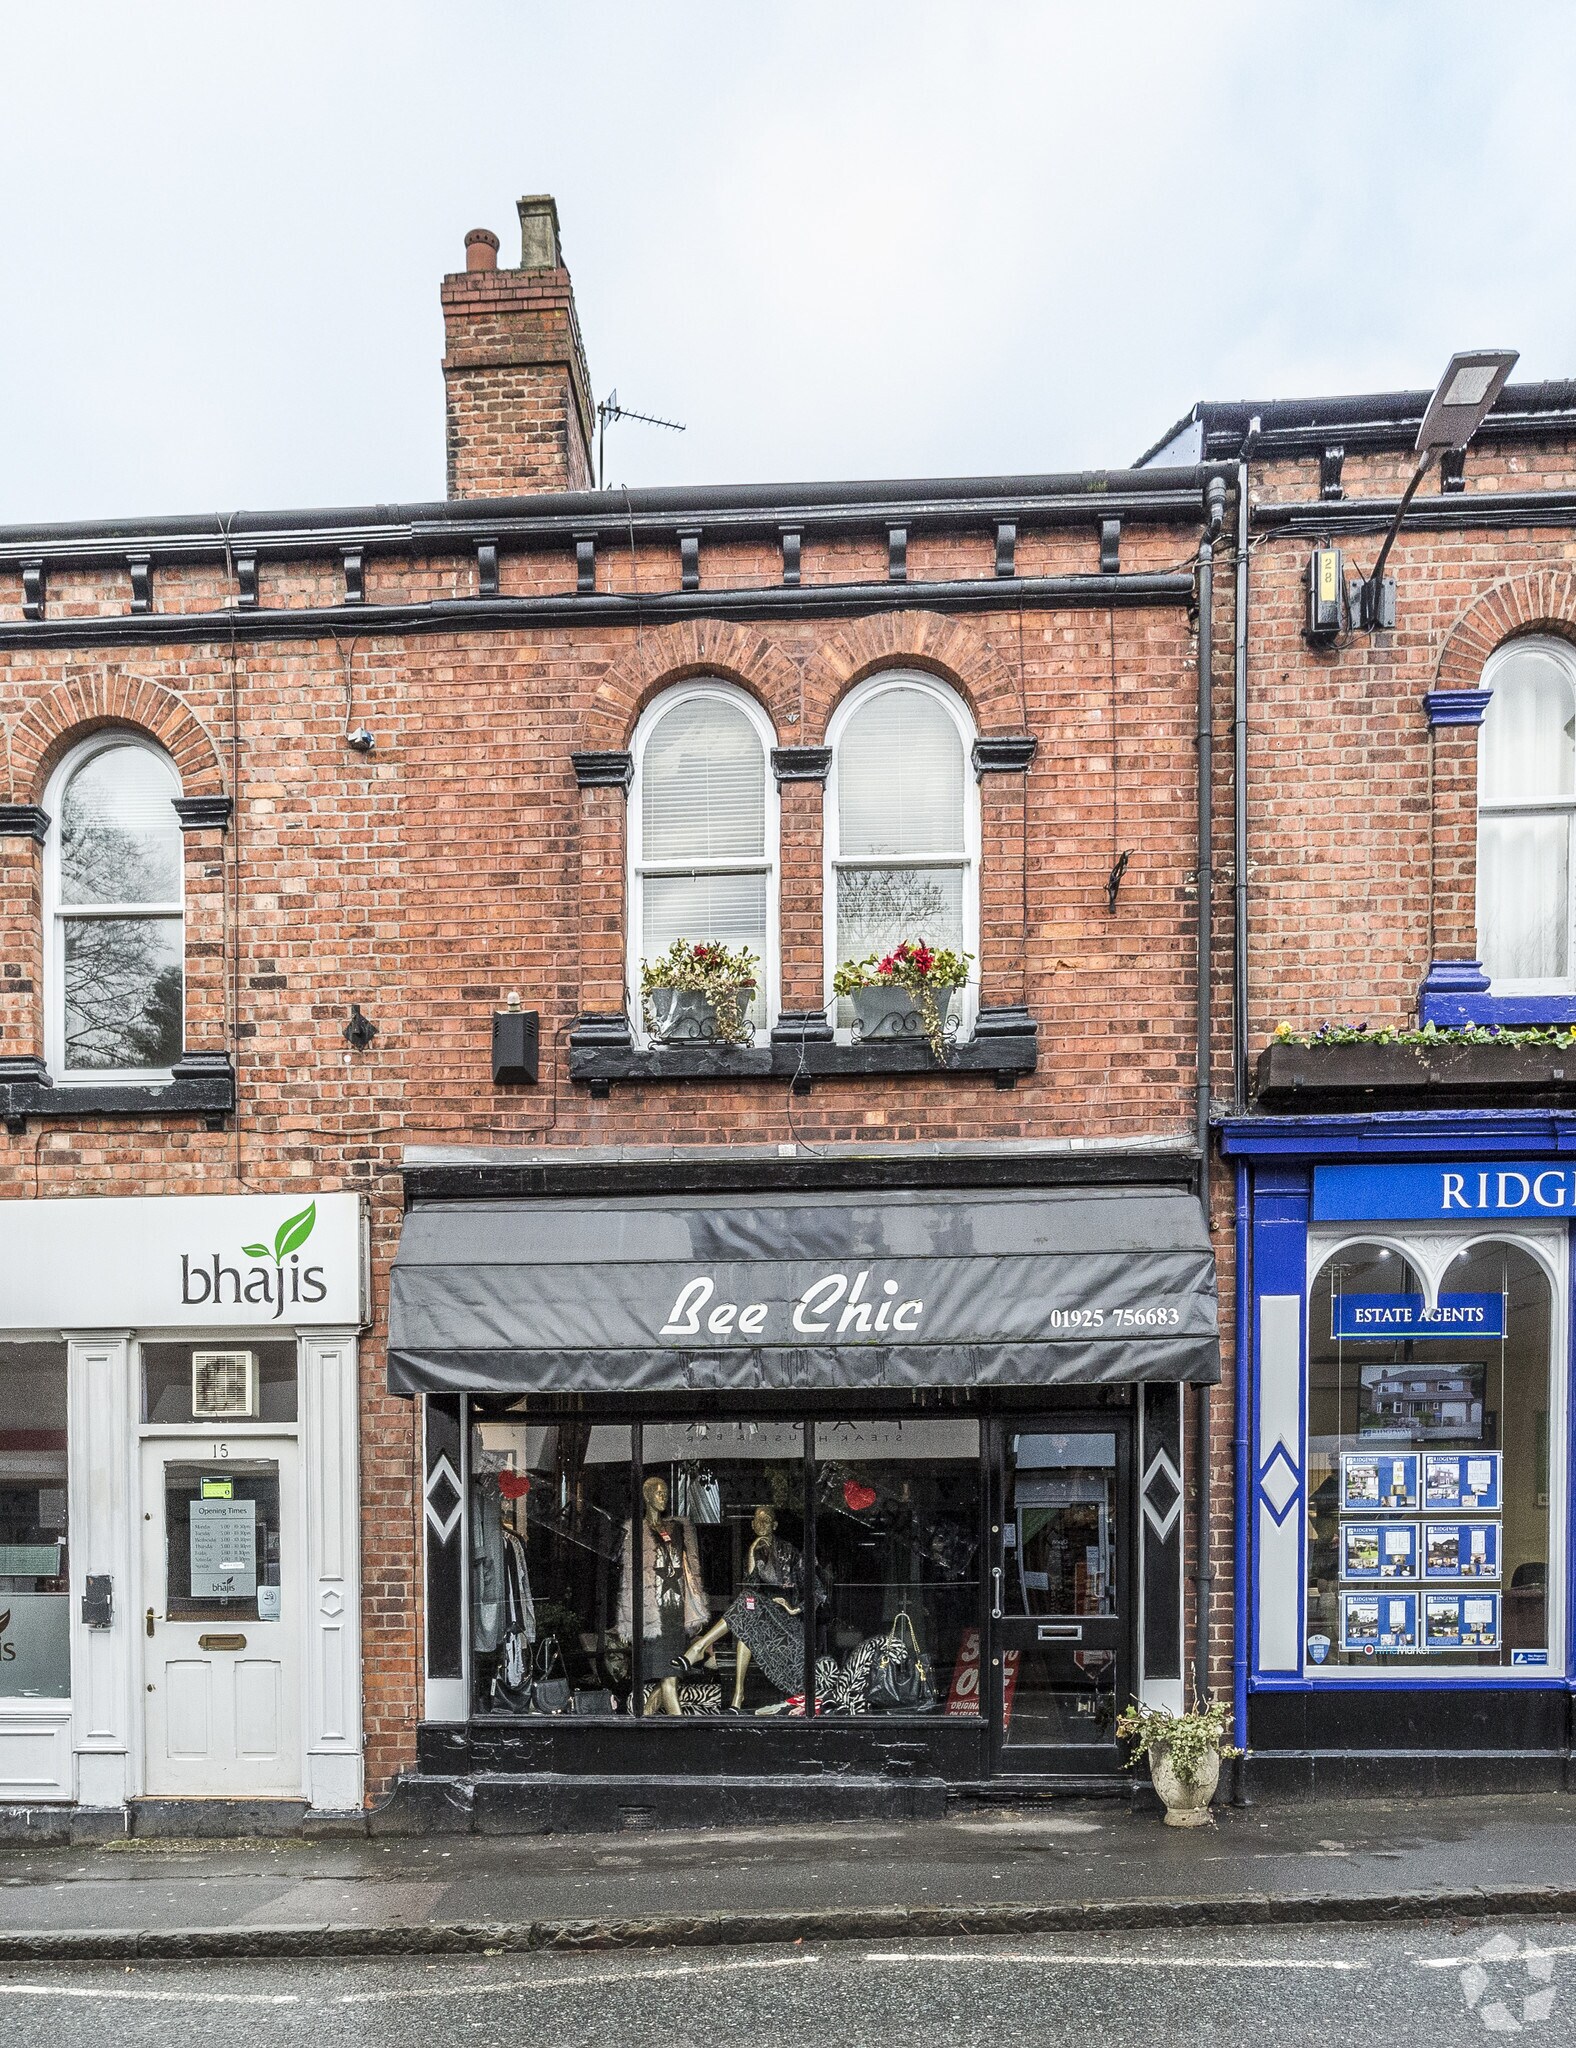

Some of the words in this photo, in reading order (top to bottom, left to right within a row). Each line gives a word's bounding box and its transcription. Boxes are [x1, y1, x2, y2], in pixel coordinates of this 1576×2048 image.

[1440, 1170, 1576, 1209] RIDG
[180, 1253, 328, 1320] bhajis
[658, 1276, 769, 1335] Bee
[792, 1270, 924, 1333] Chic
[1050, 1309, 1104, 1328] 01925
[1112, 1307, 1180, 1327] 756683
[1355, 1308, 1413, 1323] ESTATE
[1417, 1307, 1484, 1322] AGENTS
[213, 1443, 229, 1458] 15
[198, 1507, 227, 1516] Opening
[212, 1582, 236, 1594] bhajis
